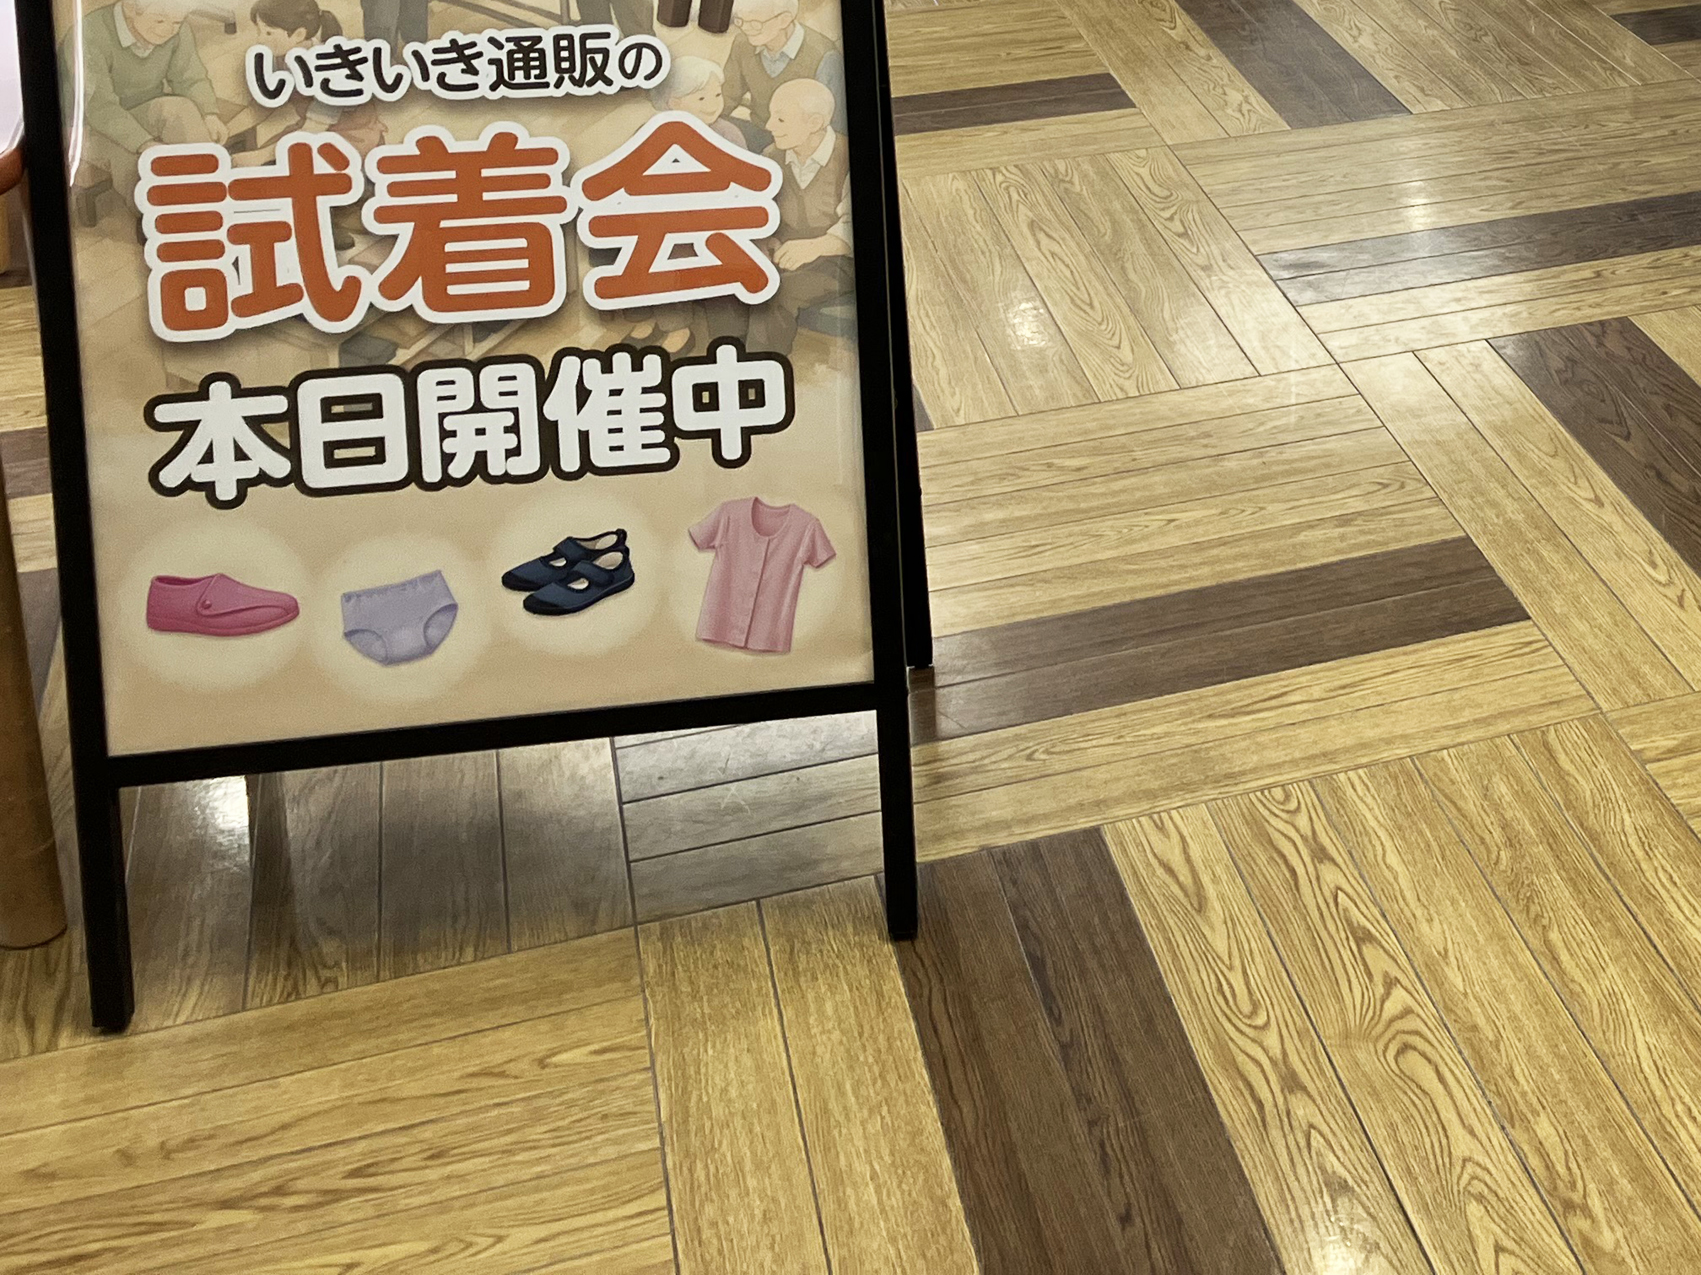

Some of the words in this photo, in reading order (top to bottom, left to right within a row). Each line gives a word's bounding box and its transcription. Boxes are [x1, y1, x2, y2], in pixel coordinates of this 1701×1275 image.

[253, 30, 664, 100] いきいき通販の
[146, 120, 773, 332] 試着会
[152, 346, 789, 503] 本日開催中
